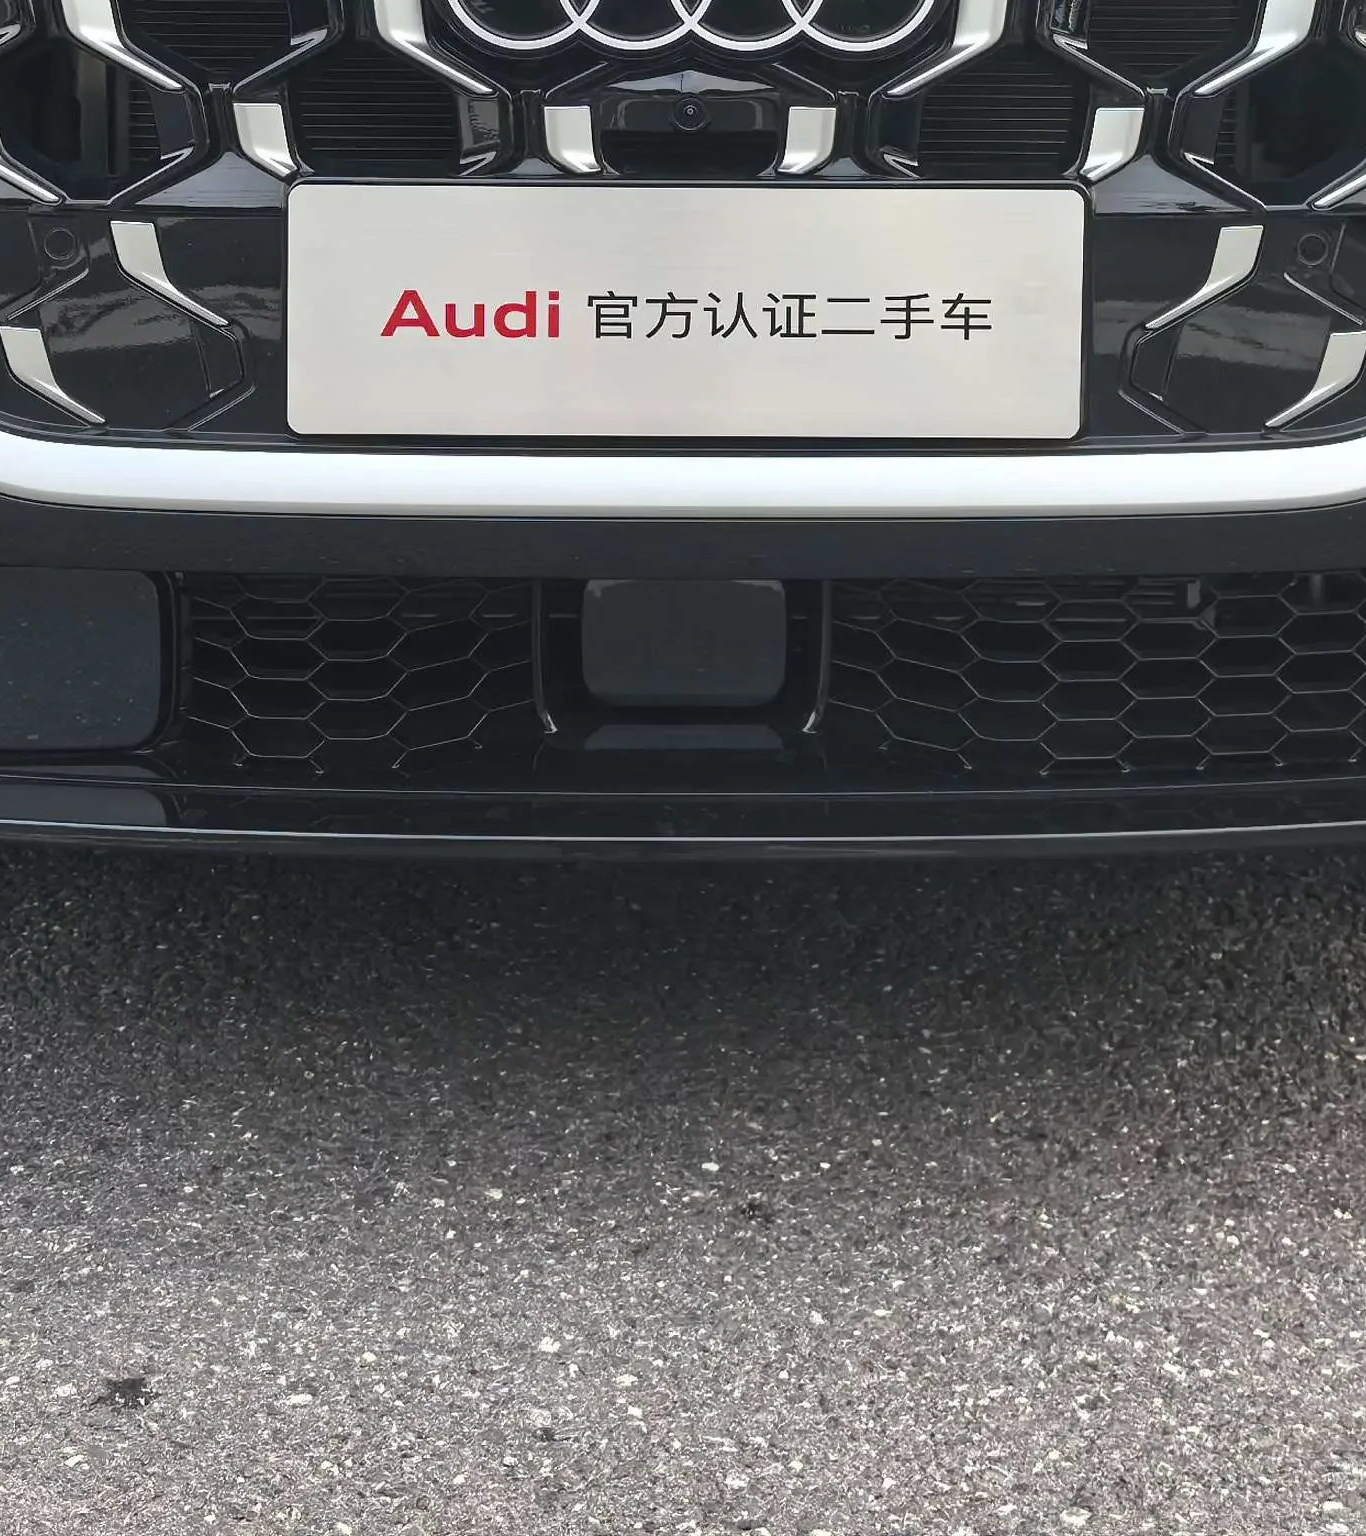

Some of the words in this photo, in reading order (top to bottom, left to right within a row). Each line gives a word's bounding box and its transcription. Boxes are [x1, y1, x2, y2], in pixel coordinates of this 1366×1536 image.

[380, 289, 560, 339] Audi
[587, 290, 993, 341] 官方认证二手车
